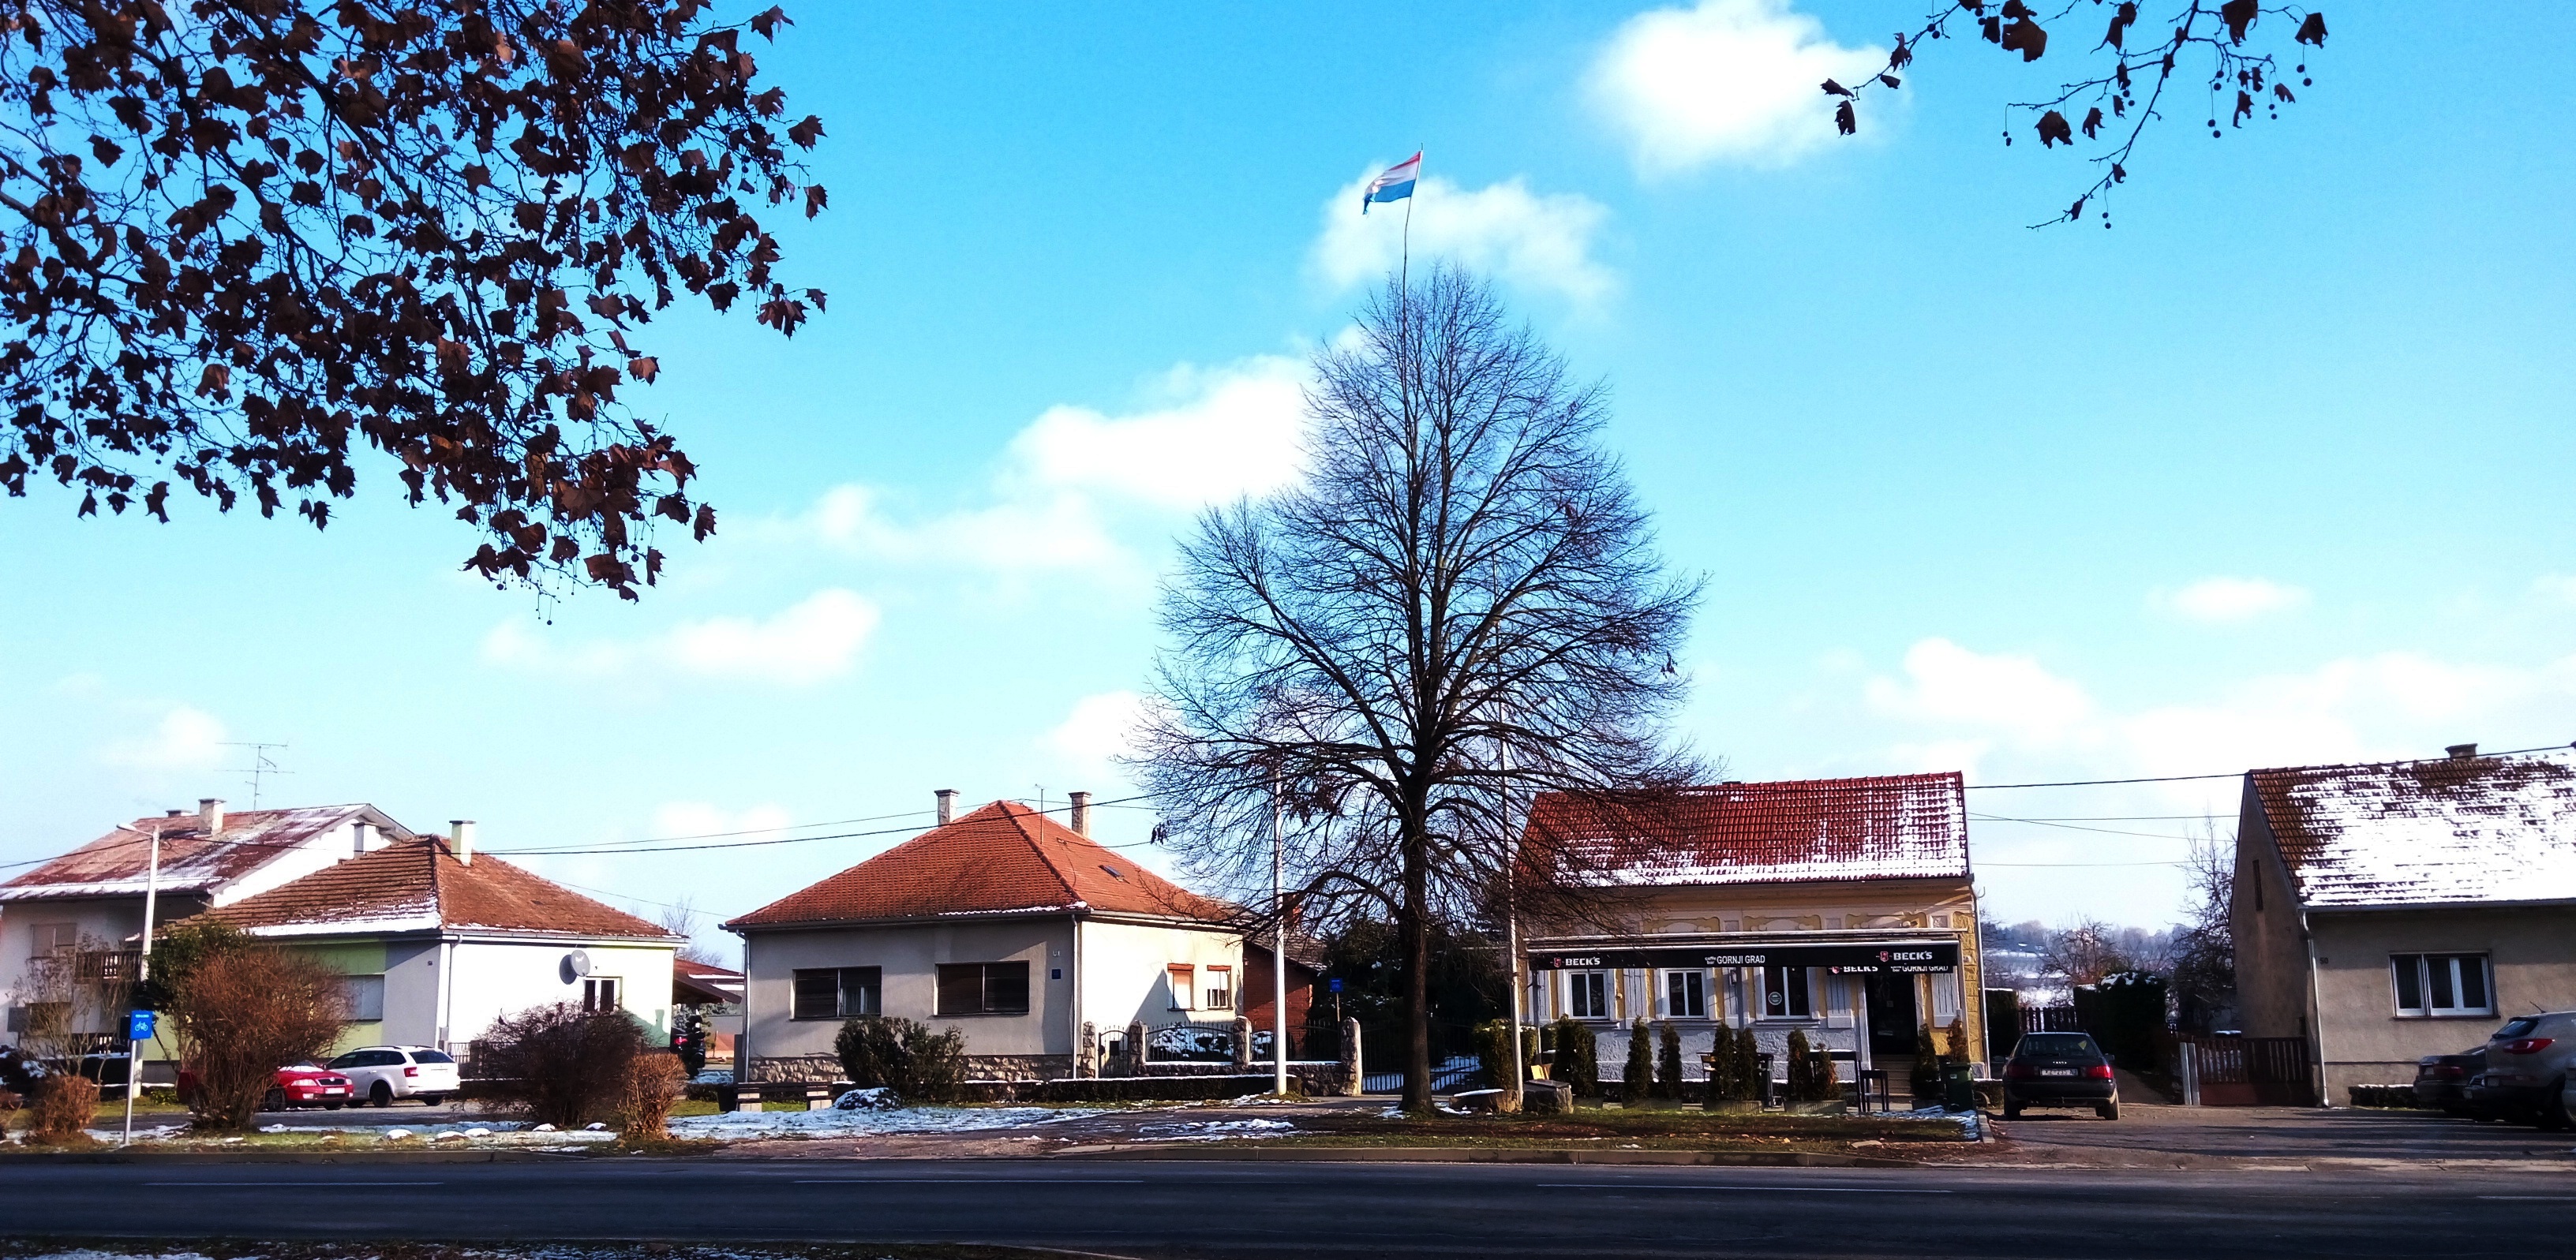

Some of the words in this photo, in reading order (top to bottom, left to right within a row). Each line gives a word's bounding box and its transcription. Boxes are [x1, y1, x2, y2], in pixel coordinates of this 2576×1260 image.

[1717, 955, 1743, 964] GORNJI
[1744, 955, 1765, 963] GRAD
[1893, 951, 1933, 960] BECK'S
[1565, 957, 1601, 966] BECK'S
